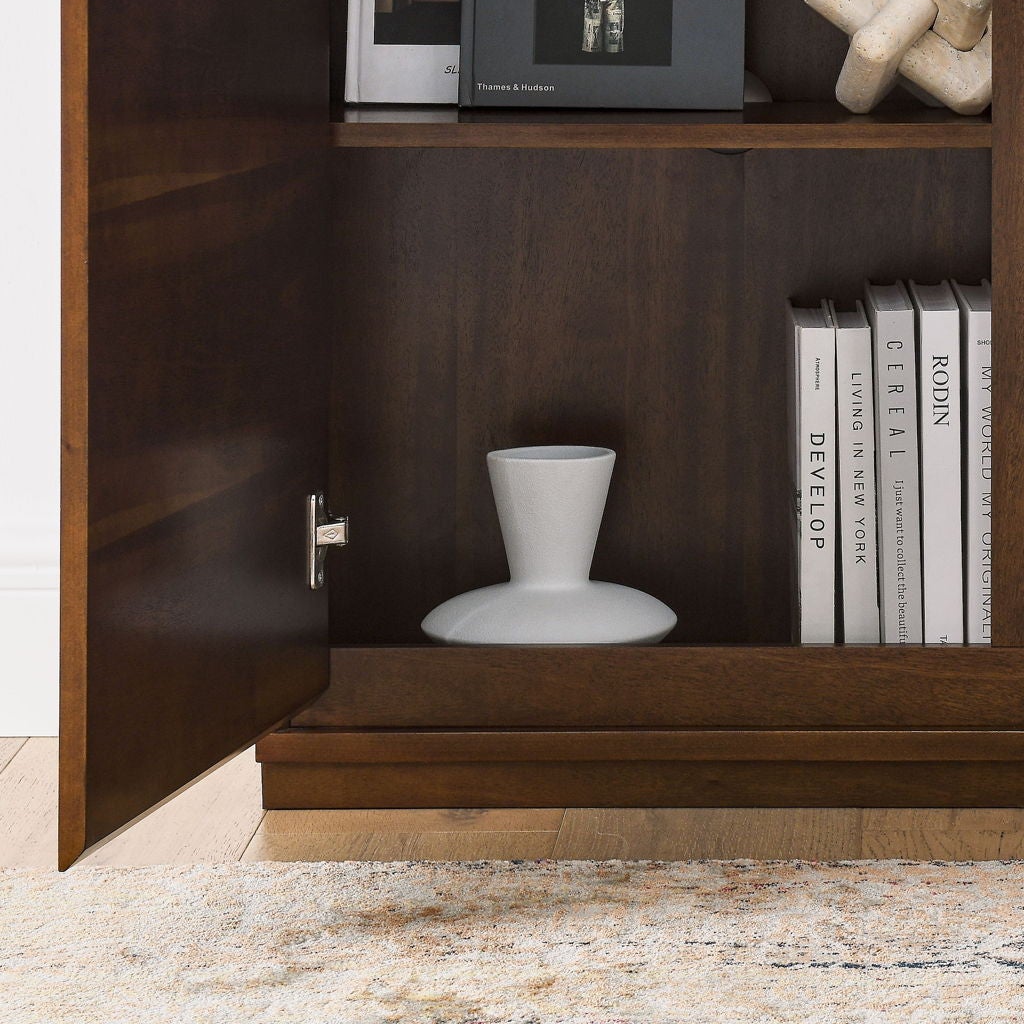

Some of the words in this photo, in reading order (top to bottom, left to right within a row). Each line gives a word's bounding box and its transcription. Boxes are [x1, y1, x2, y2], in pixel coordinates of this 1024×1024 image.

[444, 65, 460, 74] SL
[477, 82, 511, 91] Thames
[512, 83, 519, 91] &
[521, 83, 555, 92] Hudson
[851, 372, 863, 431] LIVING
[886, 340, 906, 458] CEREAL
[932, 355, 950, 427] RODIN
[853, 442, 864, 458] IN
[809, 433, 825, 549] DEVELOP
[854, 470, 865, 507] NEW
[893, 486, 904, 506] just
[895, 508, 904, 533] want
[855, 517, 866, 564] YORK
[896, 536, 904, 546] to
[896, 548, 906, 581] collect
[897, 583, 907, 600] the
